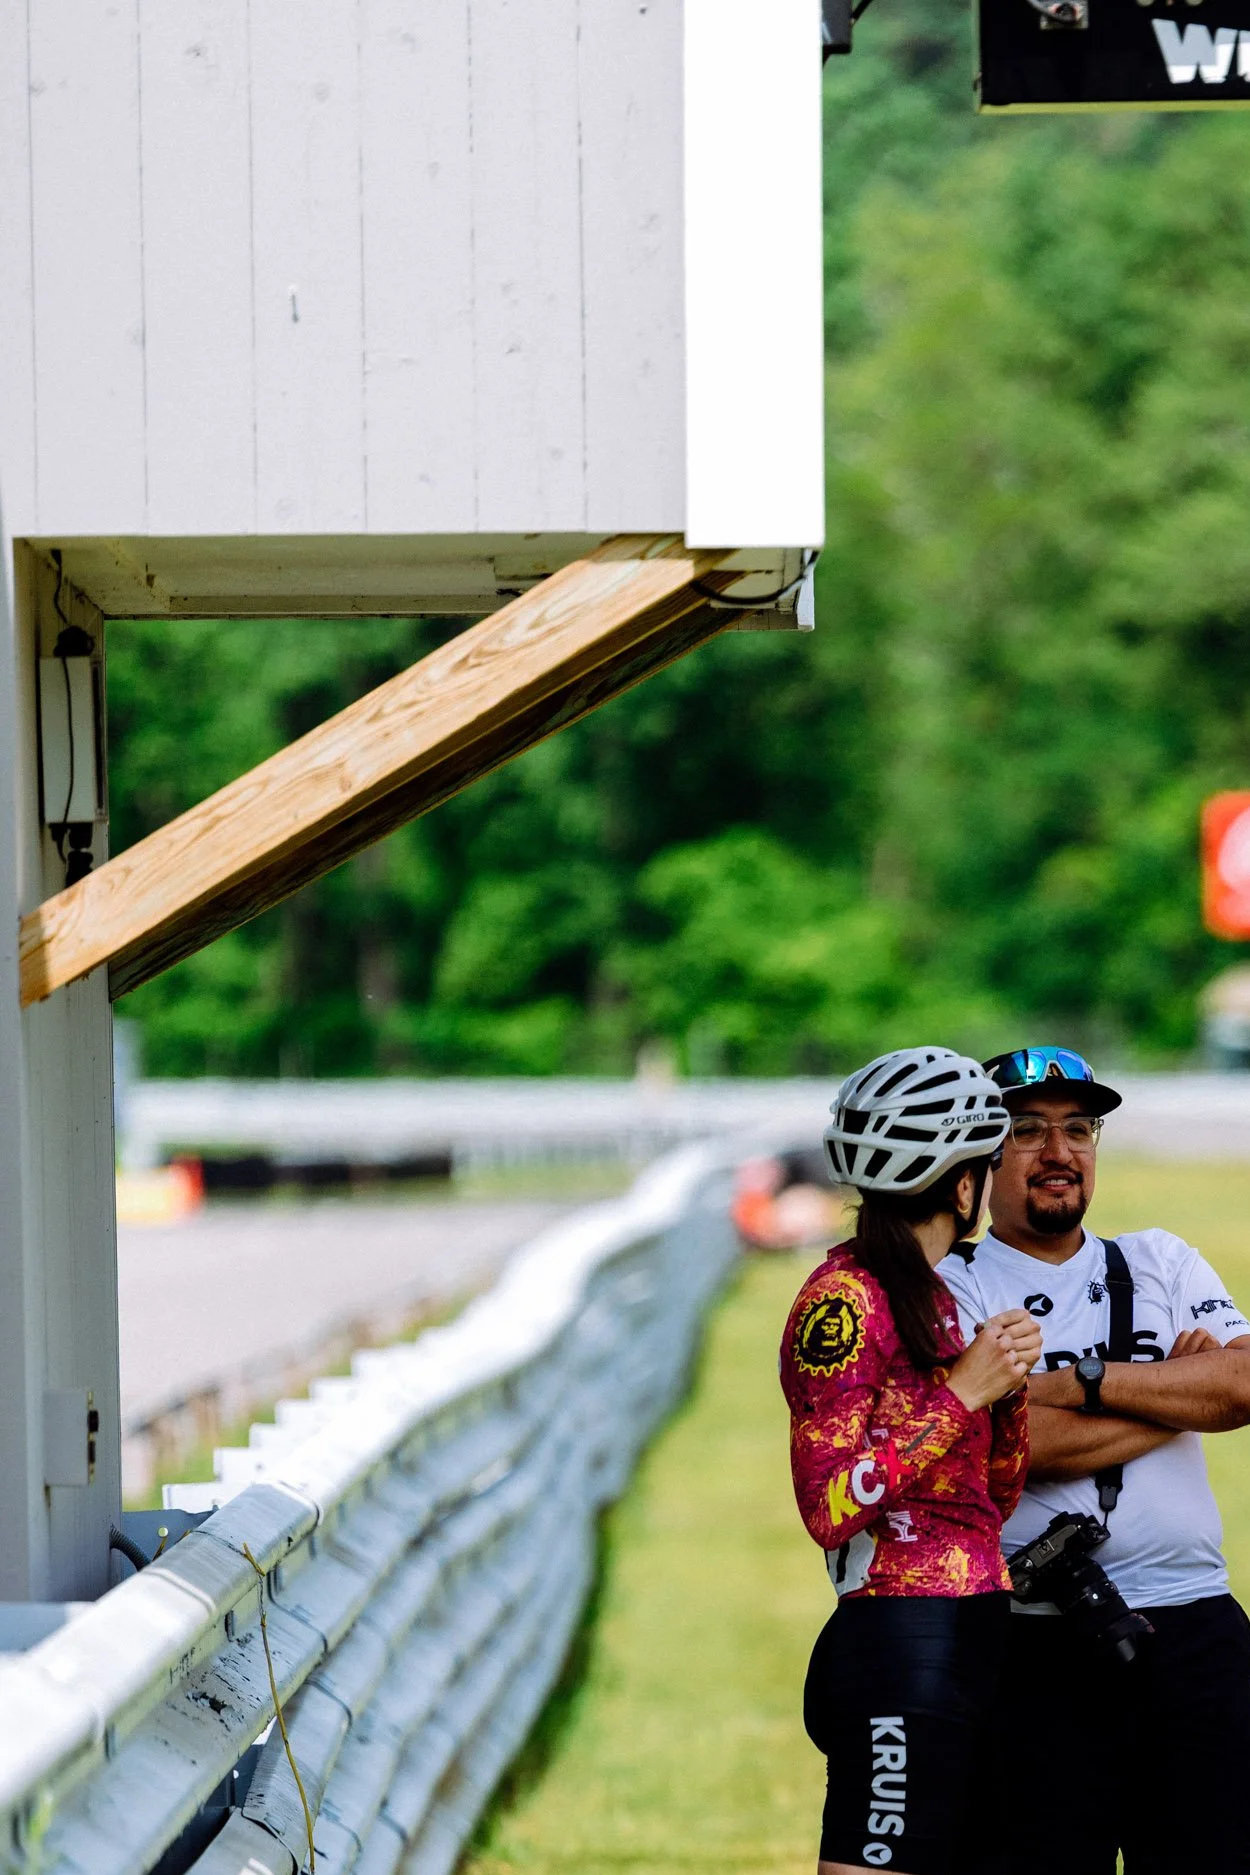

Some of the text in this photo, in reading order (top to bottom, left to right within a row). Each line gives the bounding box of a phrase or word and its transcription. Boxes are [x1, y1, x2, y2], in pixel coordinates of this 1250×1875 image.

[957, 1113, 984, 1124] GIRO
[827, 1440, 914, 1526] KCX
[868, 1716, 907, 1836] KRUIS
